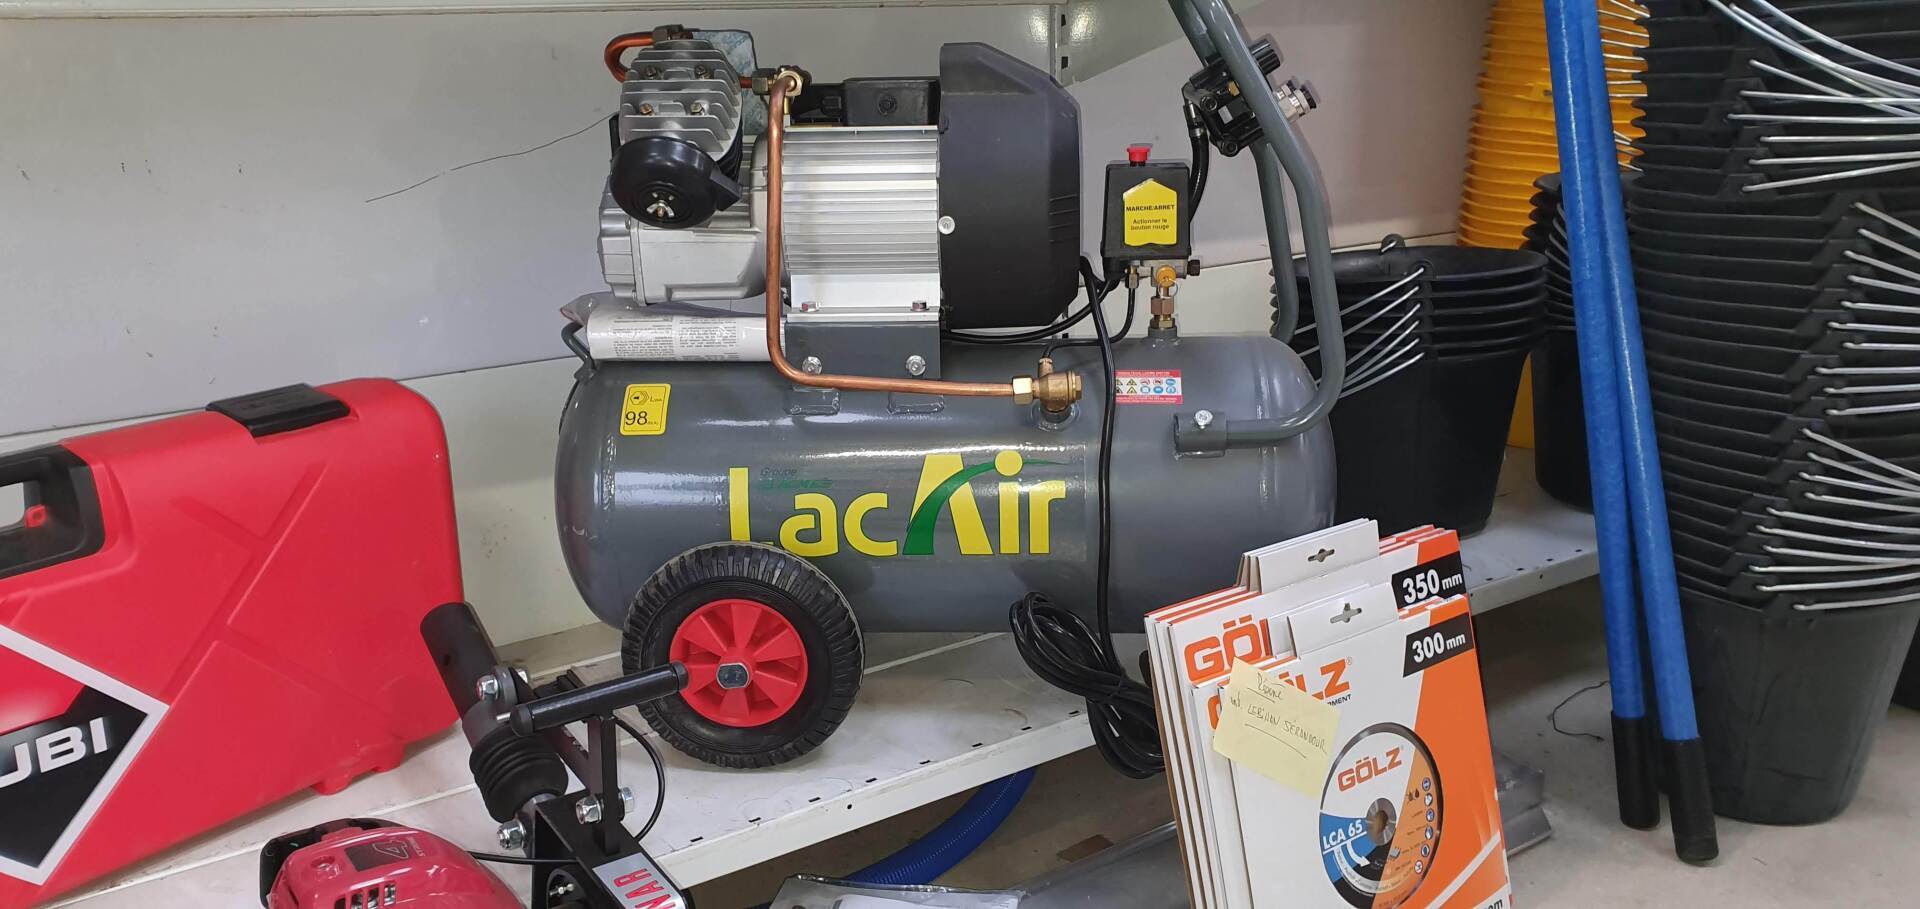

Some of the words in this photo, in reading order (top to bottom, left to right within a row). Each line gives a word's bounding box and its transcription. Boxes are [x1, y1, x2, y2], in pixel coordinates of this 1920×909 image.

[625, 411, 648, 426] 98
[729, 450, 1067, 558] LacAir
[1402, 568, 1440, 604] 350
[1441, 573, 1463, 591] mm
[1412, 631, 1445, 663] 300
[1445, 633, 1466, 650] mm
[1337, 747, 1402, 792] GÖLZ
[1323, 828, 1346, 850] LCA
[1348, 819, 1363, 837] 65
